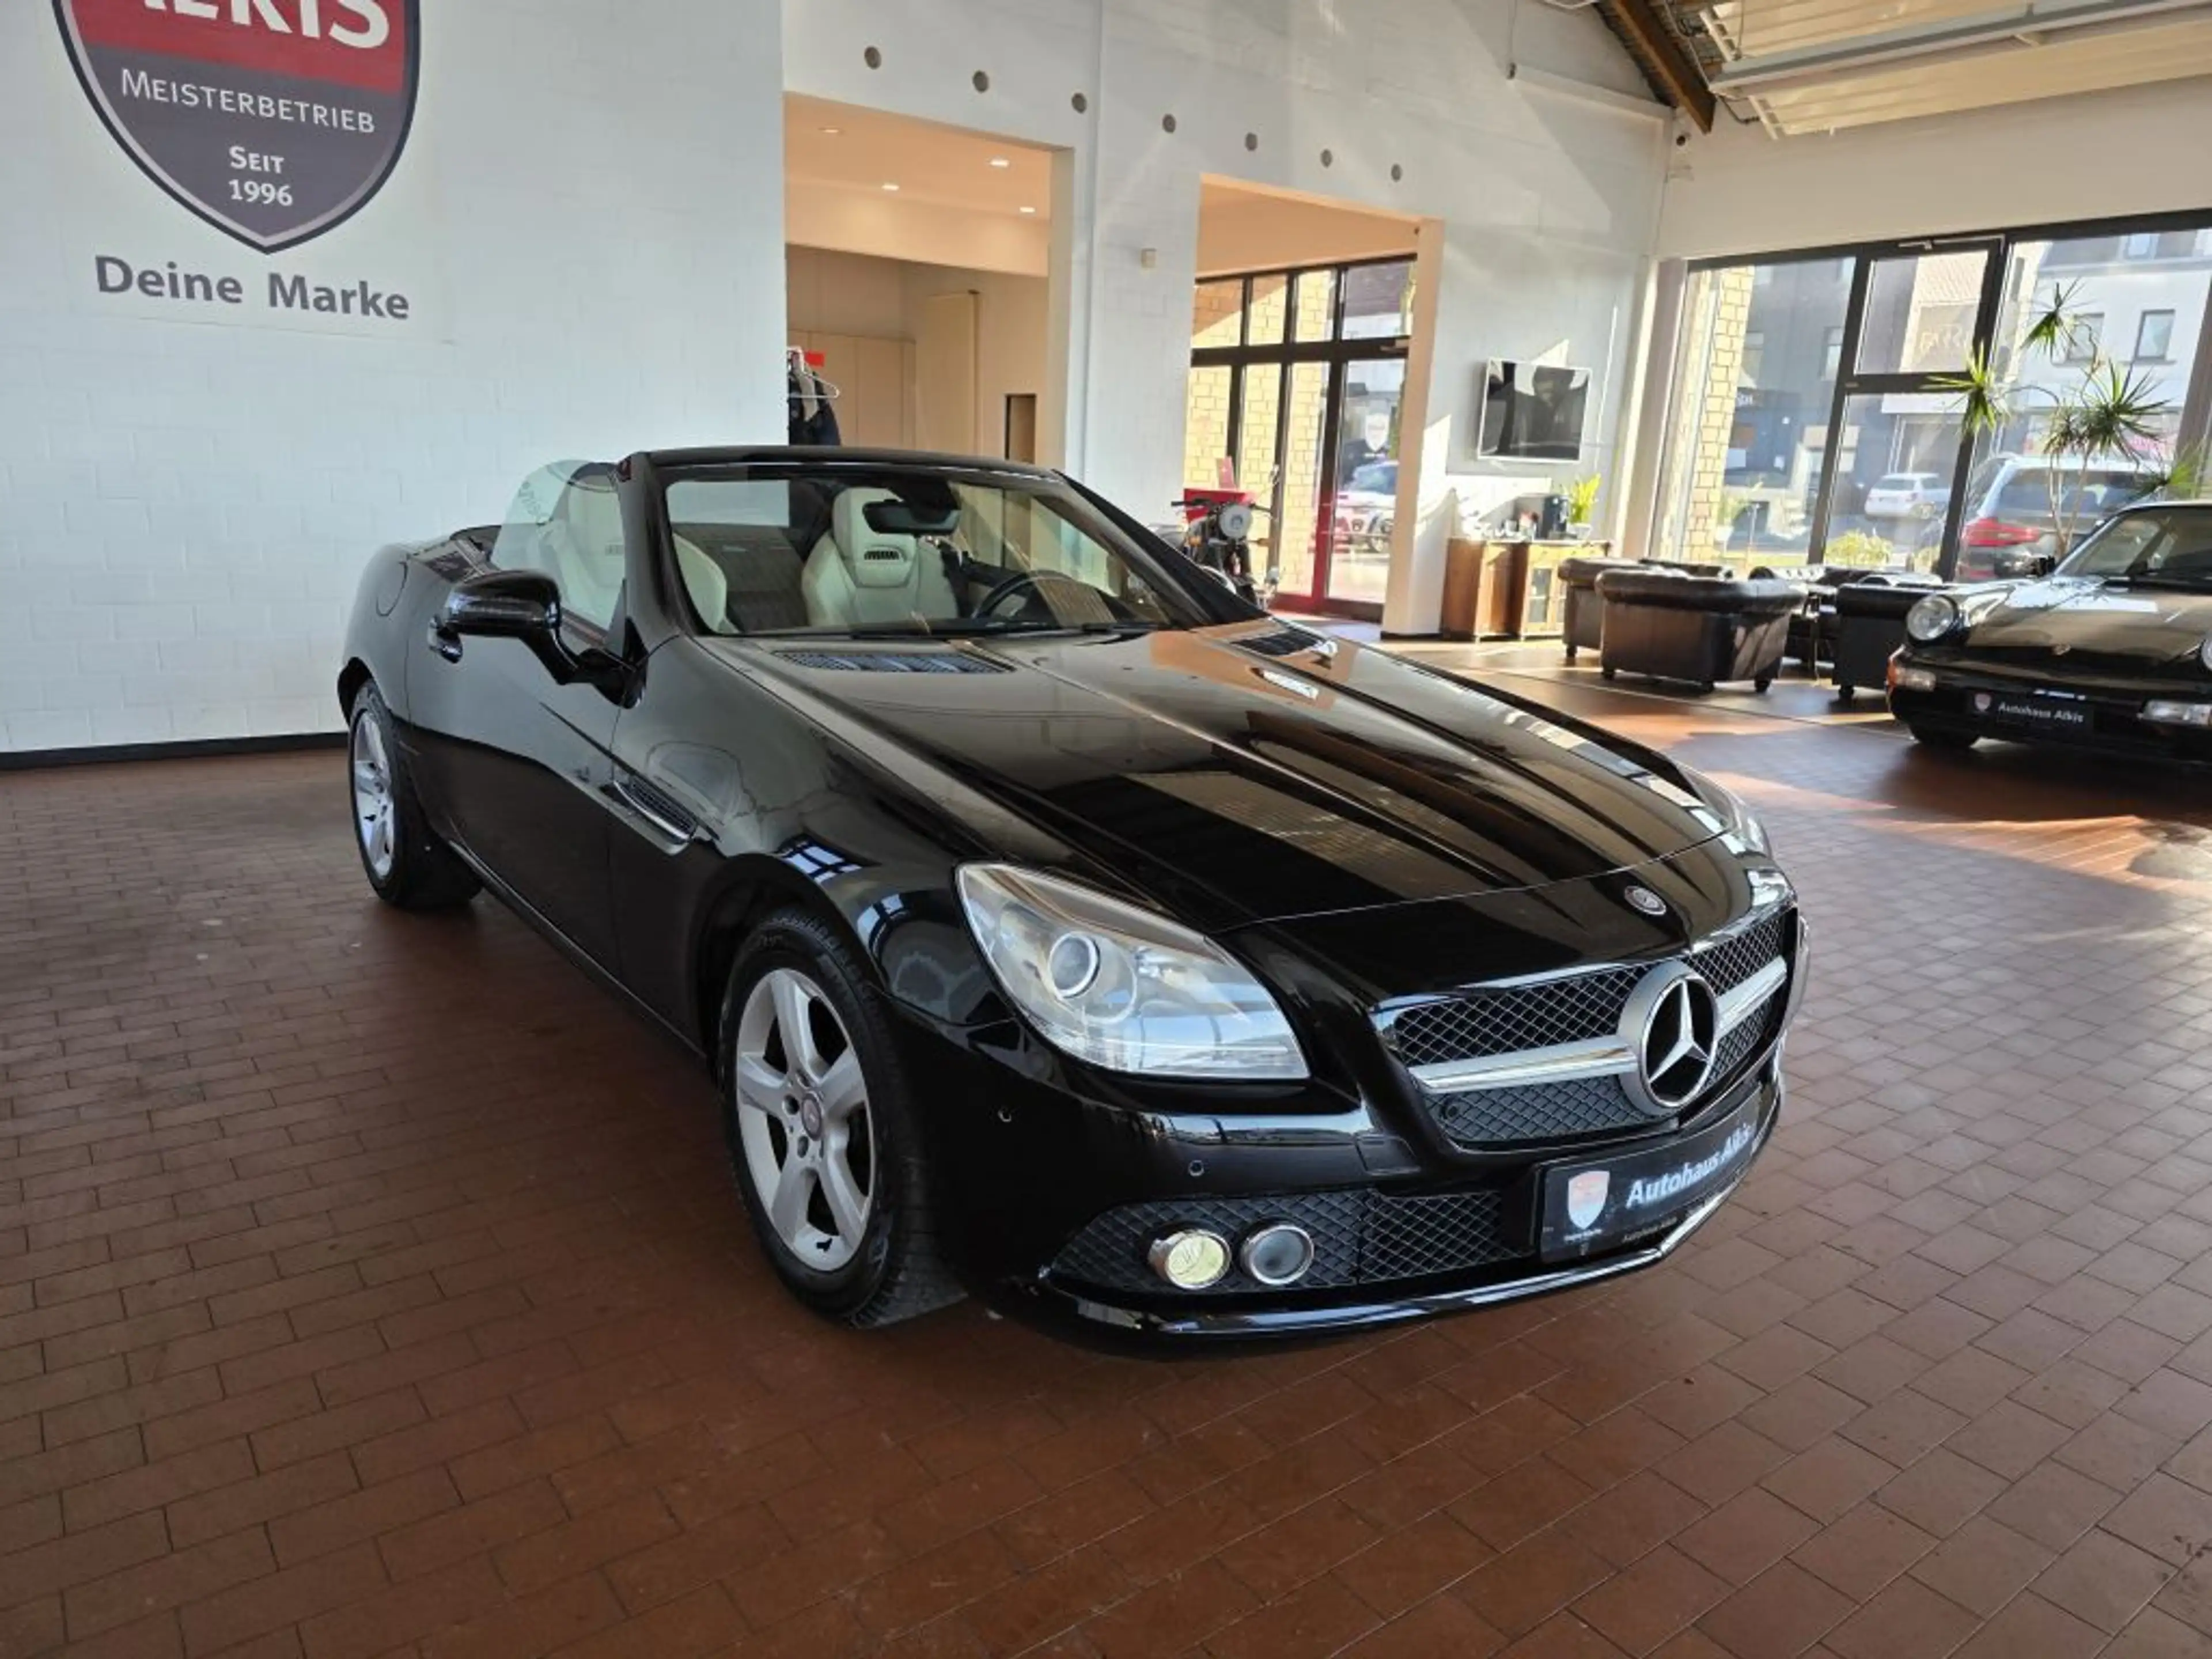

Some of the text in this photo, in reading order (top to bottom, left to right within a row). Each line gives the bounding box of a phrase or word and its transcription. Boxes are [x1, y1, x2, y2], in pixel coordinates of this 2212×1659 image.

[120, 68, 376, 133] MEISTERBETRIEB
[229, 146, 285, 174] SEIT
[229, 179, 294, 206] 1996
[94, 255, 410, 320] Deine Marke
[1625, 1152, 1720, 1210] Autohaus
